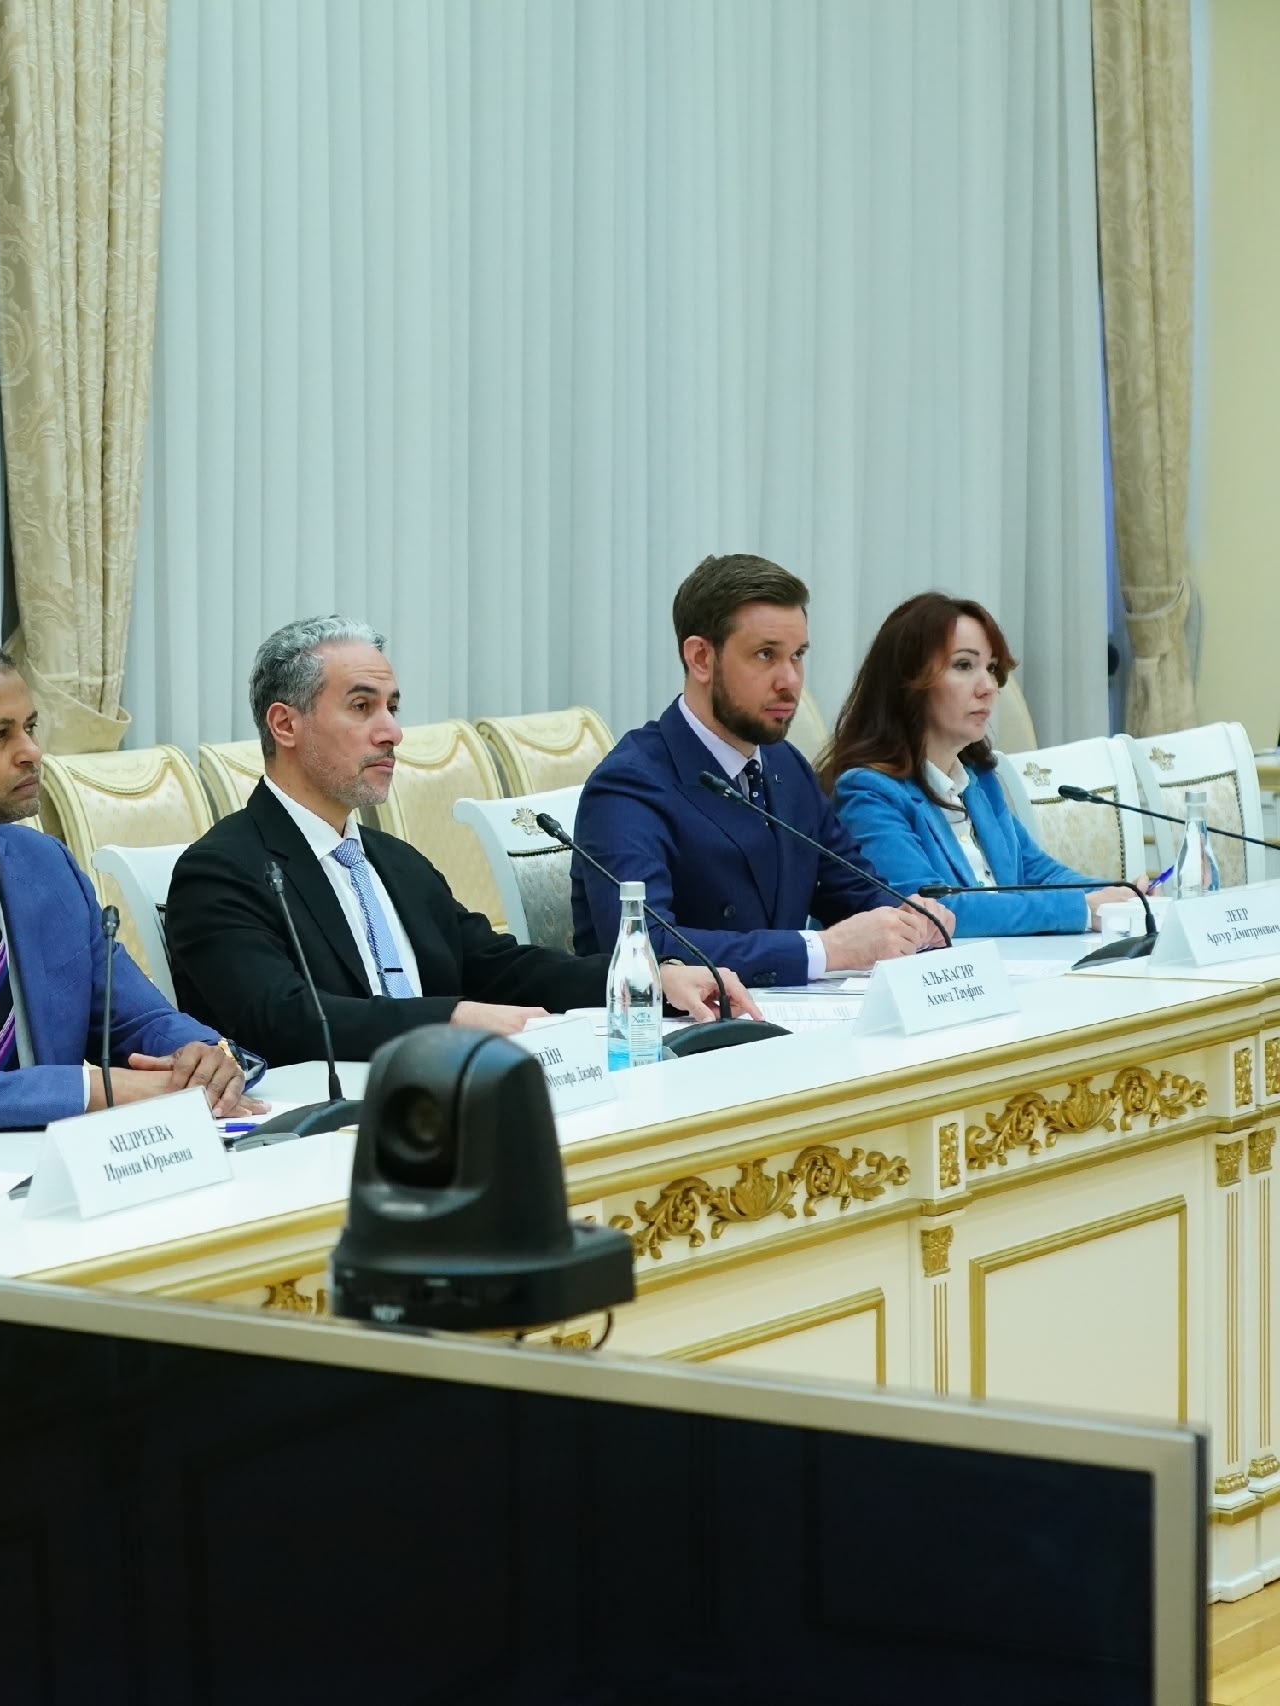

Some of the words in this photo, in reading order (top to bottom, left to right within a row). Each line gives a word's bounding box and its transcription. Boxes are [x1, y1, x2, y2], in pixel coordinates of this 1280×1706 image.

[1225, 907, 1248, 922] ЛЕЕР
[1207, 931, 1232, 946] Артур
[109, 1124, 175, 1153] АНДРЕЕВА
[103, 1162, 143, 1184] Ирина
[141, 1148, 193, 1173] Юрьевна
